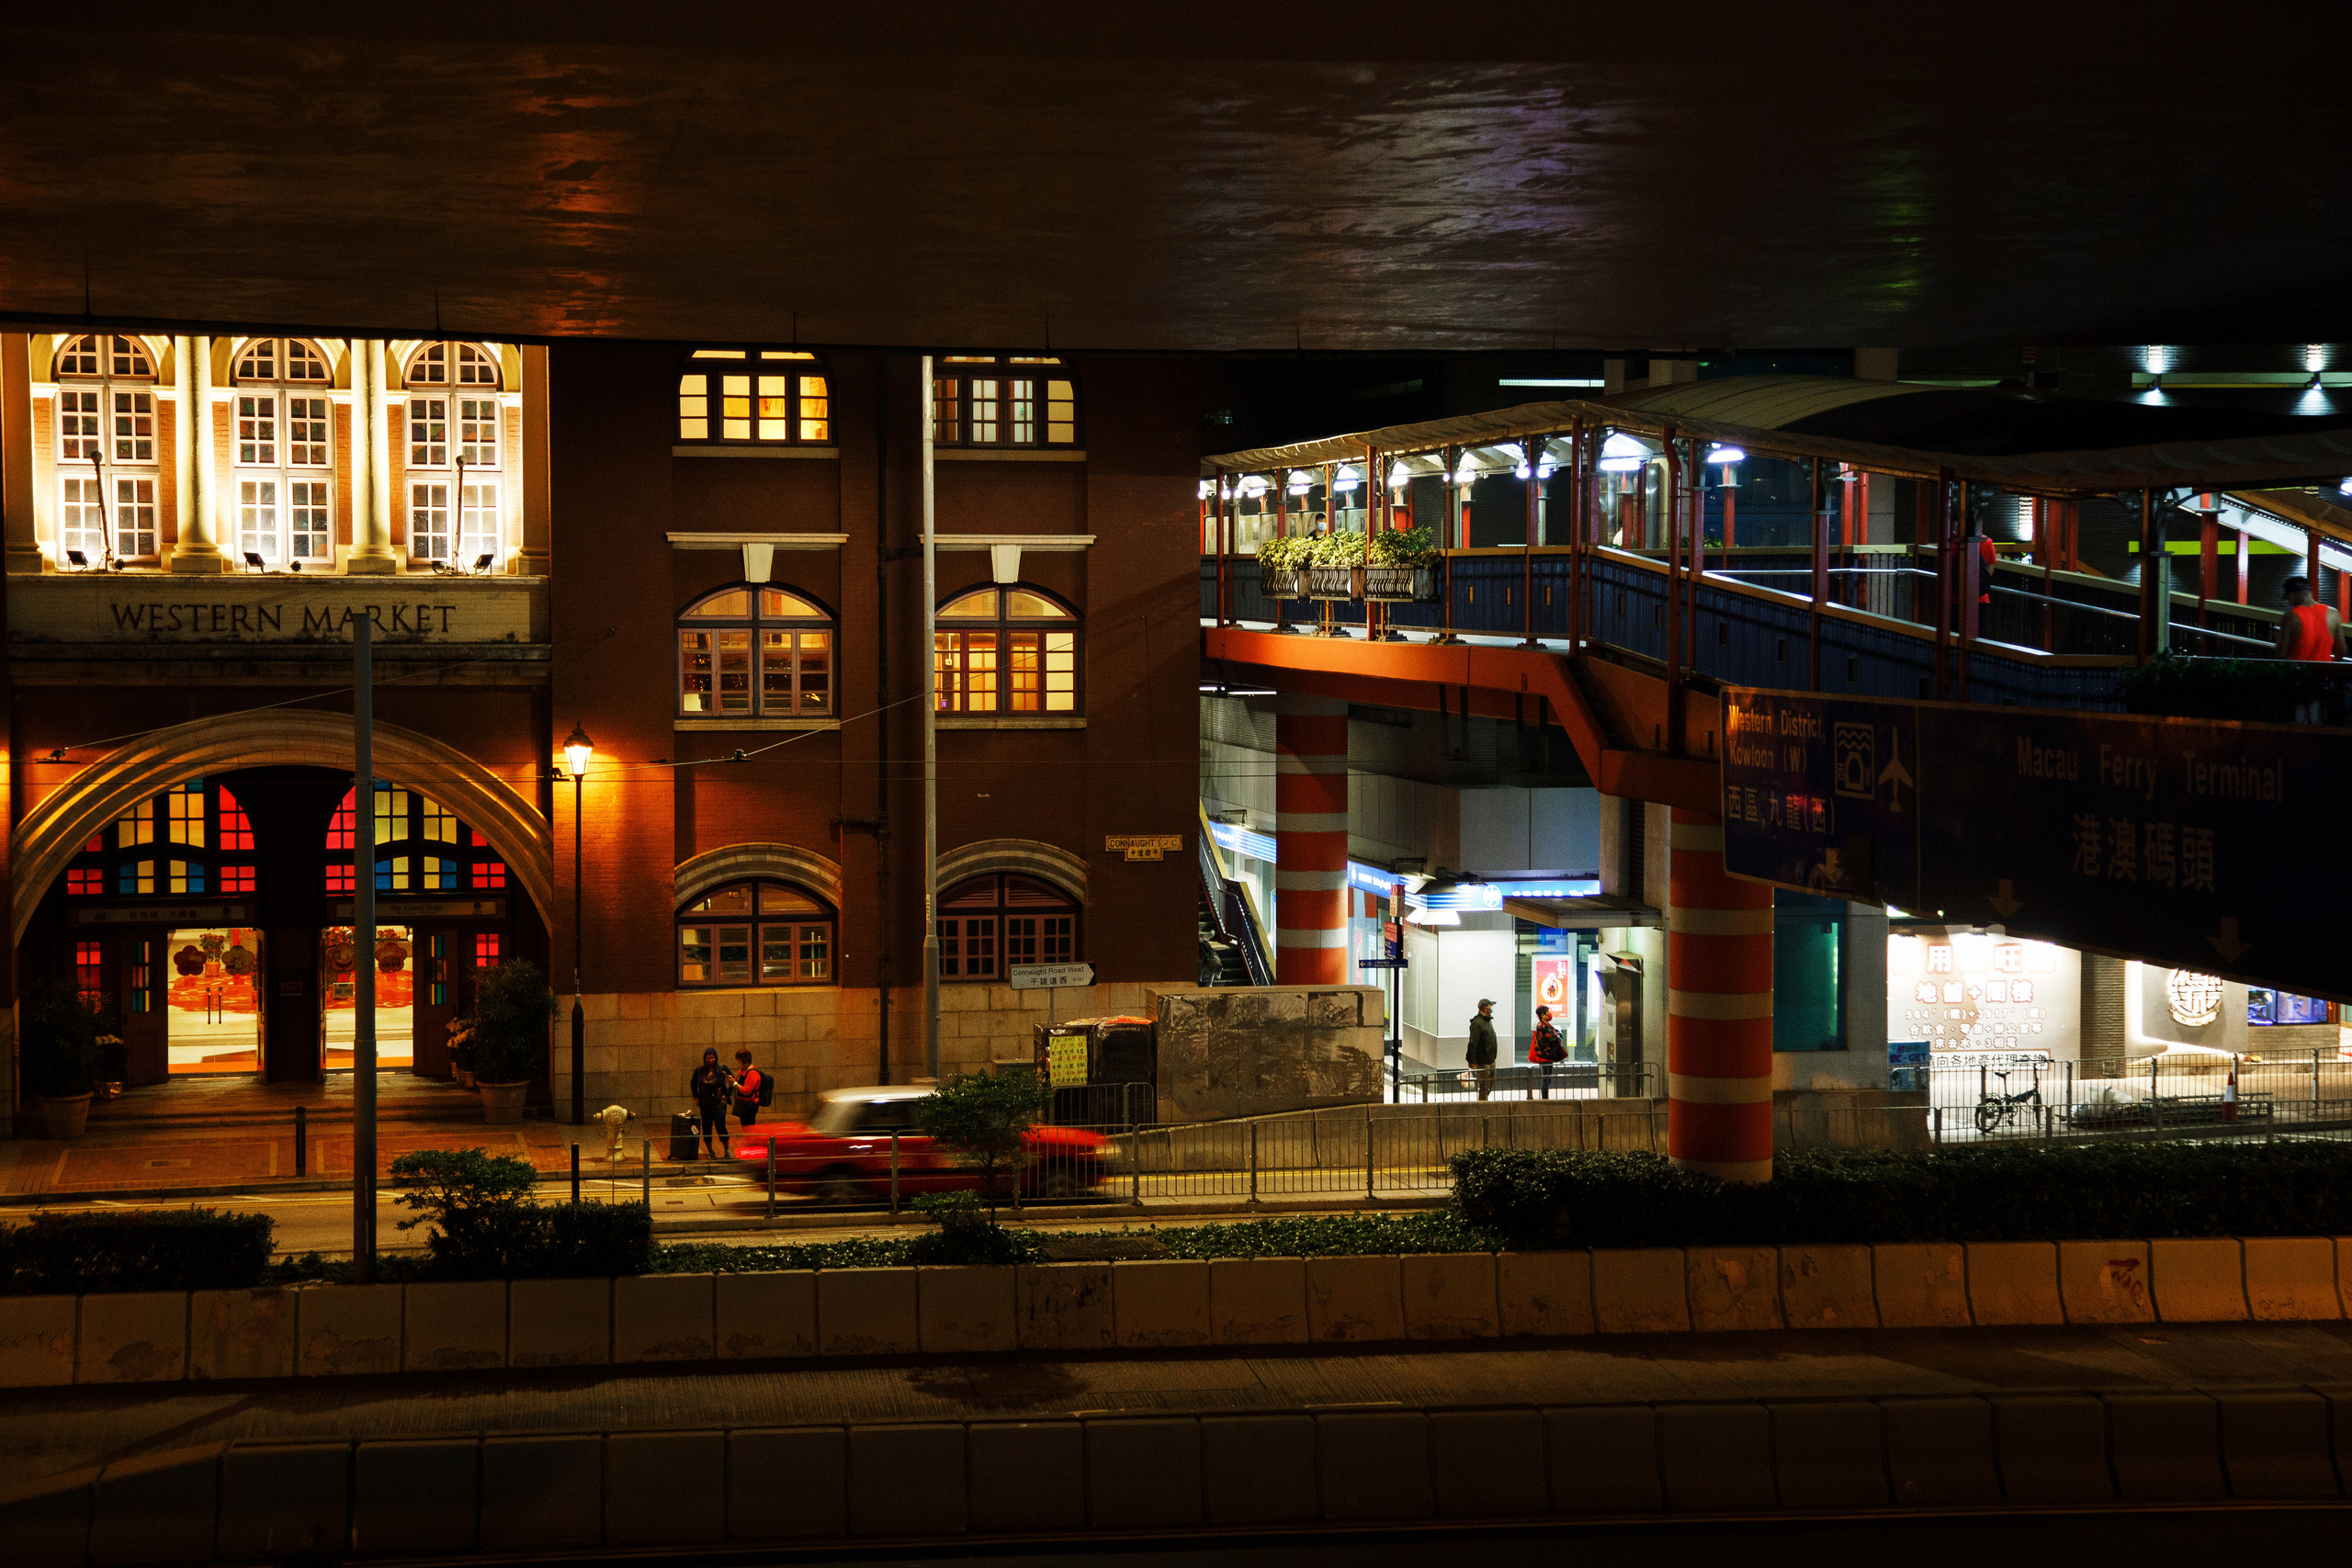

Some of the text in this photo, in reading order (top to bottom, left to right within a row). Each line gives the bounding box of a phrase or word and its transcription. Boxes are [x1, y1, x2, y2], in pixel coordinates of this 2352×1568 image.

[110, 603, 458, 633] WESTERN MARKET
[1728, 705, 1826, 745] Western District,
[1729, 740, 1807, 774] Kowloon (W)
[2017, 735, 2284, 803] Macau Ferry Terminal
[1110, 839, 1155, 848] CONNAUGHT
[2072, 812, 2216, 896] 港澳碼頭
